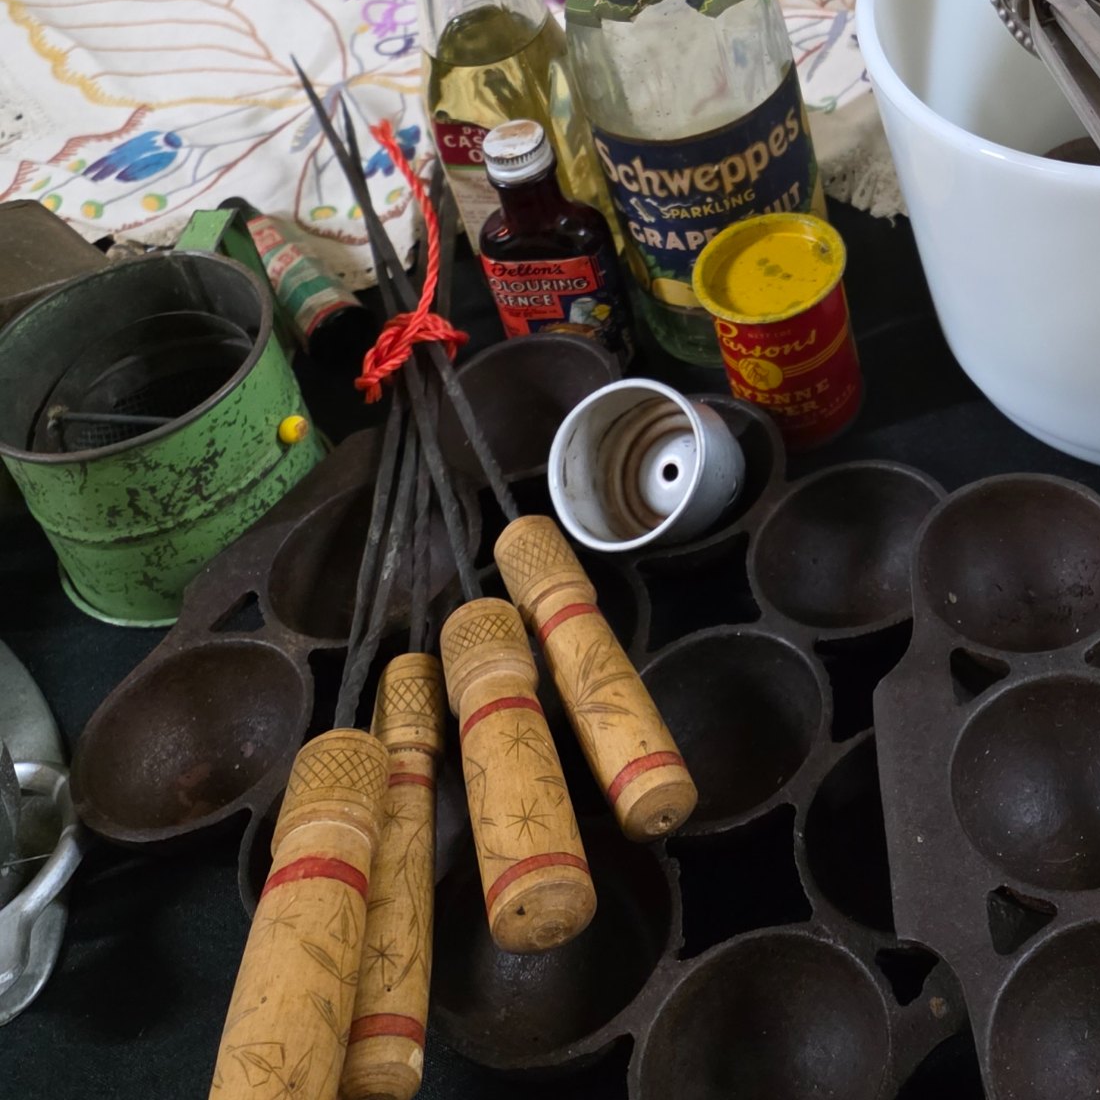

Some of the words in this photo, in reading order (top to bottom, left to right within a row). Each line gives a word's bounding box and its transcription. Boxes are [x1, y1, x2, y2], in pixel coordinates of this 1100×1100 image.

[443, 134, 484, 148] CAS
[594, 106, 799, 198] Schweppes
[660, 188, 757, 220] SPARKLING
[489, 277, 588, 293] OLOURING
[500, 294, 554, 307] SENCE
[716, 317, 816, 358] Parsons
[730, 377, 830, 404] AYENNE
